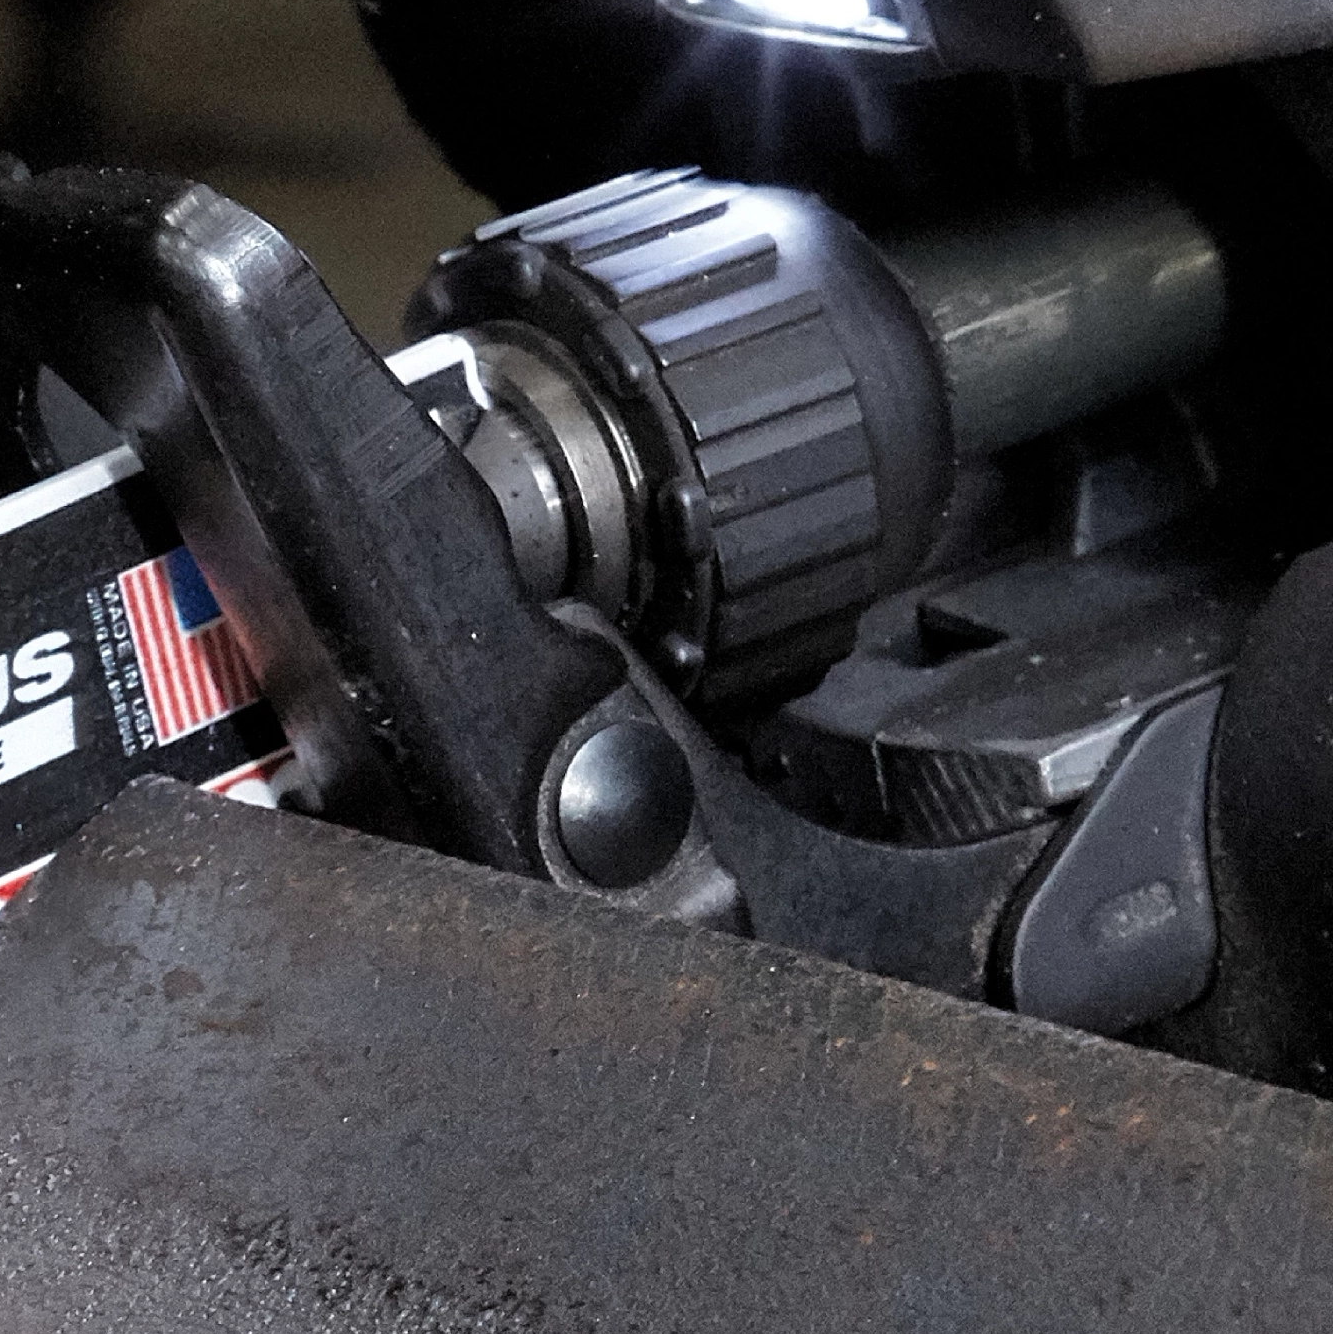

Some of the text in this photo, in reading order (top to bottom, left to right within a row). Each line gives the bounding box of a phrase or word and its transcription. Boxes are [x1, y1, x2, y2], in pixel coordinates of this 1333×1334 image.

[103, 581, 132, 658] MADE
[123, 663, 139, 690] IN
[132, 697, 155, 750] USA
